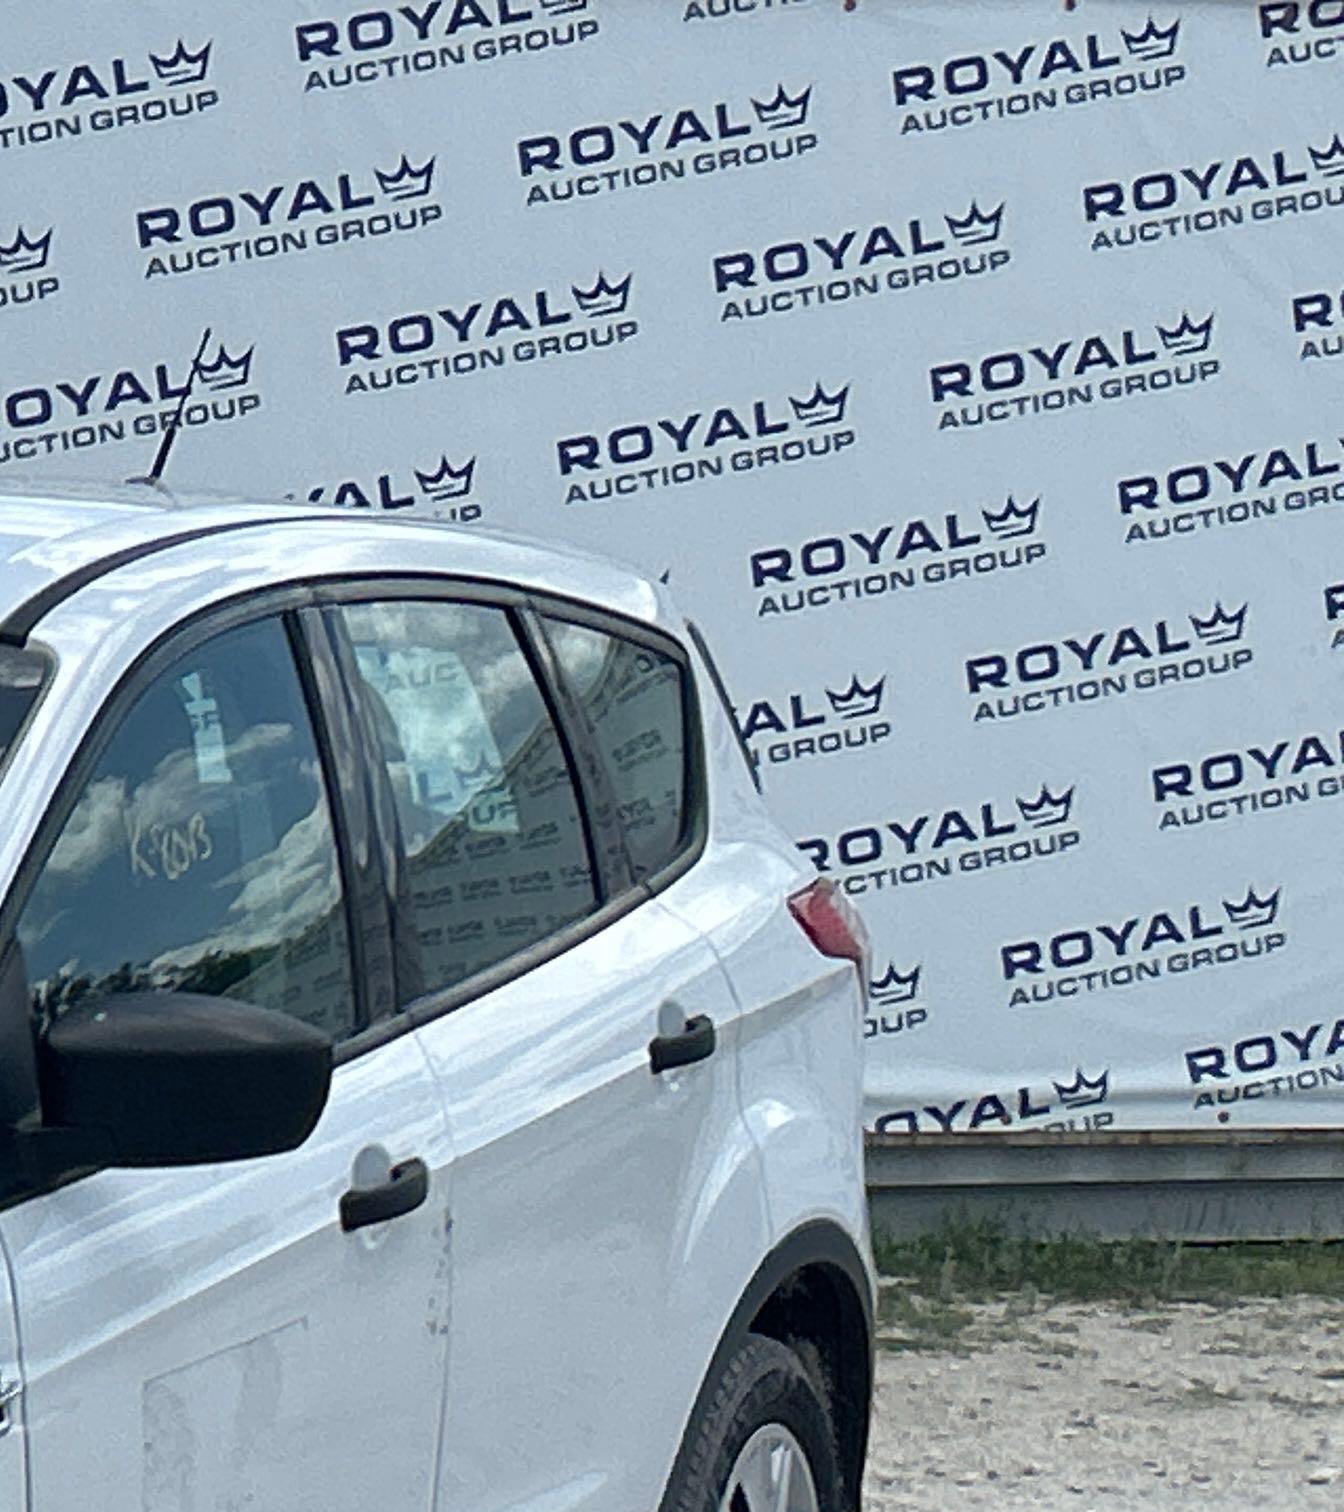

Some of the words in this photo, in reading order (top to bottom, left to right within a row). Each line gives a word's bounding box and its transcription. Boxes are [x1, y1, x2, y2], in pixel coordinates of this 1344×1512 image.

[305, 44, 465, 92] AUCTION
[473, 20, 599, 61] GROUP
[893, 34, 1121, 106] ROYAL
[90, 90, 219, 131] GROUP
[901, 88, 1057, 135] AUCTION
[1064, 65, 1185, 104] GROUP
[518, 103, 752, 177] ROYAL
[527, 159, 685, 206] AUCTION
[693, 134, 818, 174] GROUP
[136, 174, 375, 249] ROYAL
[1083, 151, 1308, 223] ROYAL
[145, 229, 307, 280] AUCTION
[315, 204, 442, 246] GROUP
[713, 220, 945, 293] ROYAL
[1091, 205, 1243, 251] AUCTION
[721, 274, 879, 322] AUCTION
[887, 250, 1010, 289] GROUP
[336, 291, 573, 366] ROYAL
[345, 346, 505, 394] AUCTION
[513, 321, 638, 362] GROUP
[930, 330, 1158, 402] ROYAL
[939, 384, 1093, 430] AUCTION
[1099, 360, 1220, 399] GROUP
[133, 394, 260, 436] GROUP
[557, 401, 790, 476] ROYAL
[565, 456, 723, 505] AUCTION
[730, 430, 855, 471] GROUP
[1118, 443, 1340, 515] ROYAL
[750, 514, 982, 588] ROYAL
[1125, 496, 1276, 543] AUCTION
[759, 568, 915, 617] AUCTION
[923, 543, 1046, 583] GROUP
[965, 620, 1191, 694] ROYAL
[974, 674, 1126, 722] AUCTION
[1134, 649, 1253, 689] GROUP
[768, 722, 891, 763] GROUP
[1158, 782, 1310, 831] AUCTION
[959, 831, 1080, 872] GROUP
[1001, 906, 1224, 980] ROYAL
[1009, 959, 1161, 1008] AUCTION
[1167, 933, 1286, 973] GROUP
[1194, 1065, 1344, 1110] AUCTION
